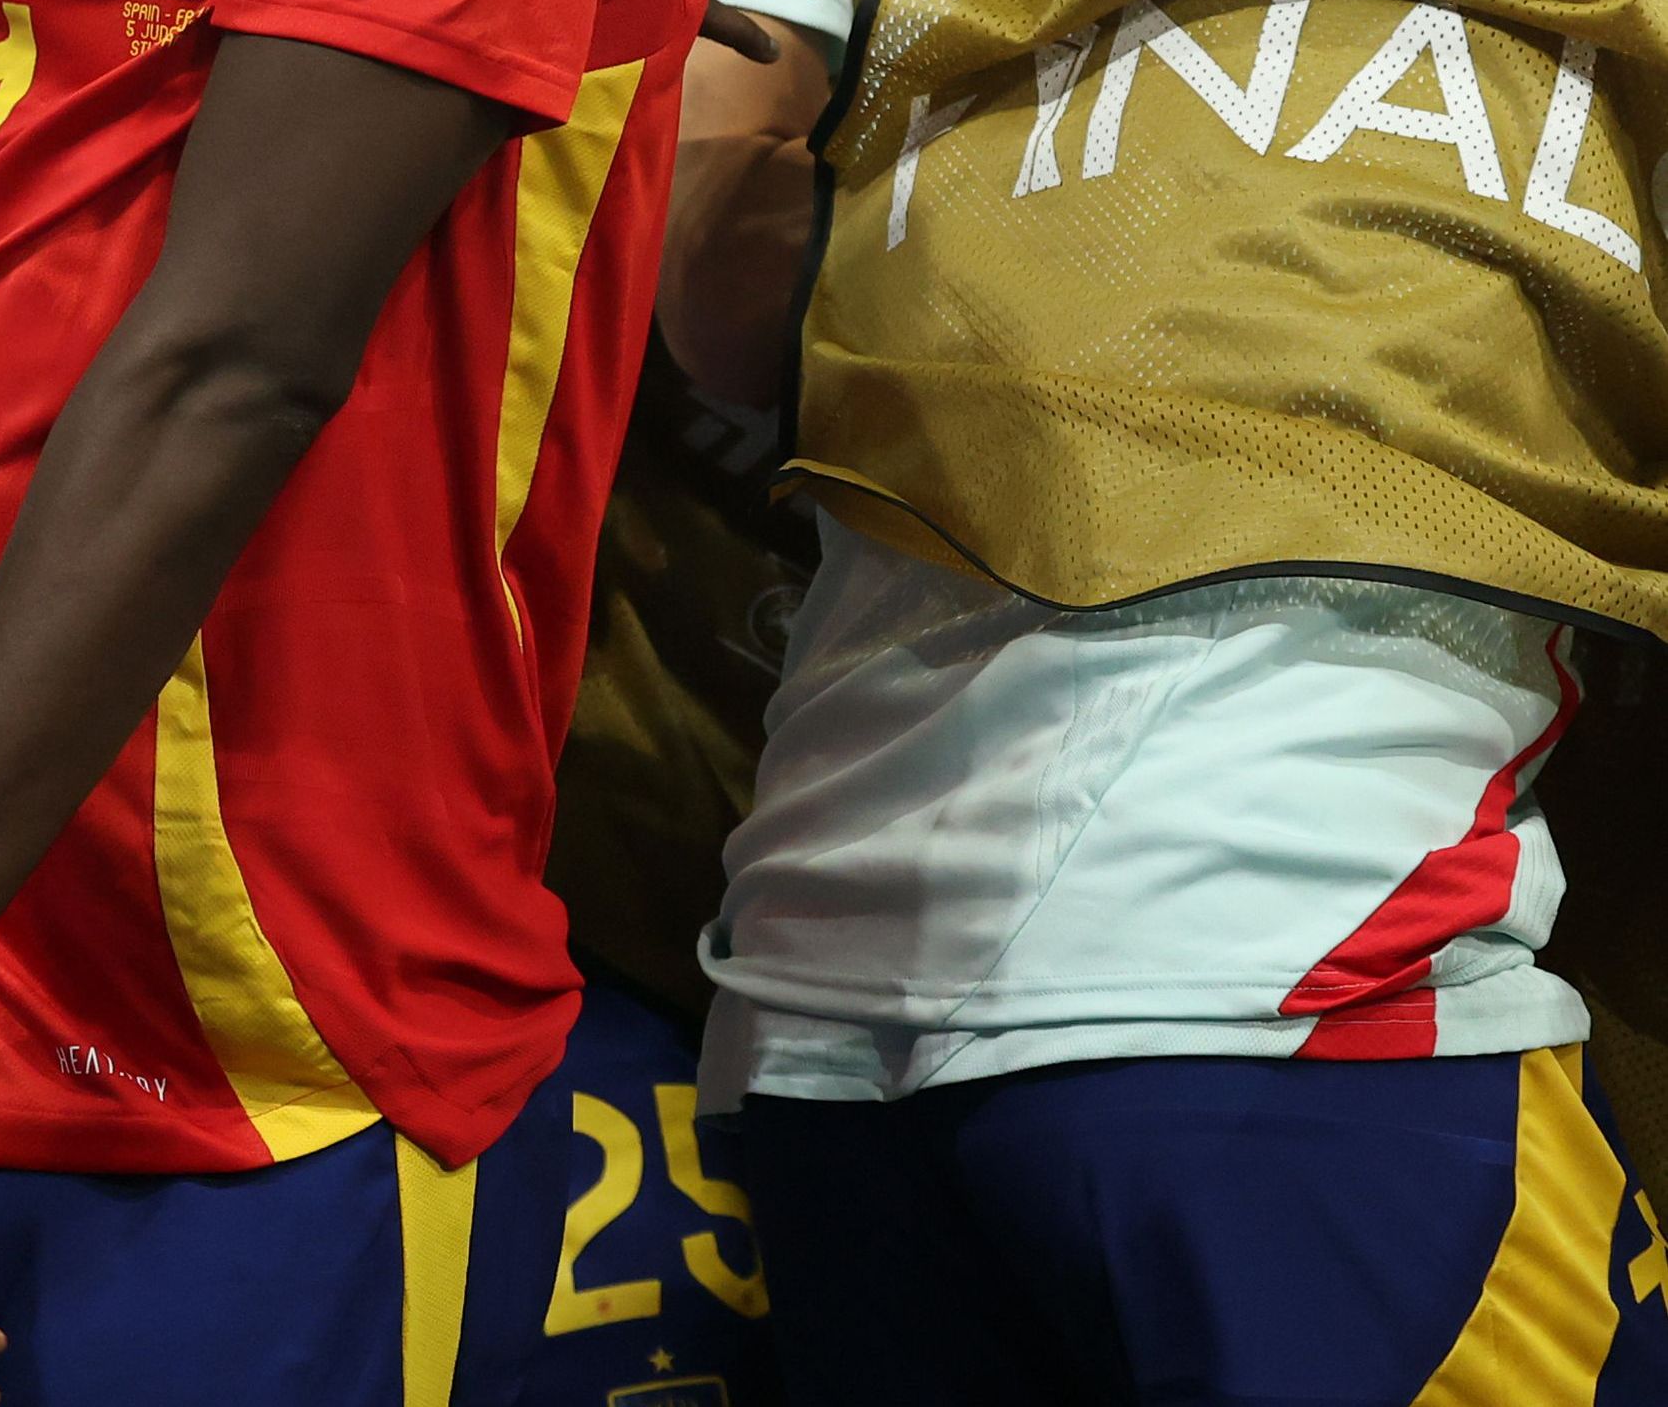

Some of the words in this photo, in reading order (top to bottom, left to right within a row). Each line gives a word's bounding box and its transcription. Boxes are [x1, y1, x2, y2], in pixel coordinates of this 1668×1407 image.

[122, 0, 161, 23] SPAIN
[125, 19, 136, 37] 5
[543, 1083, 770, 1337] 25
